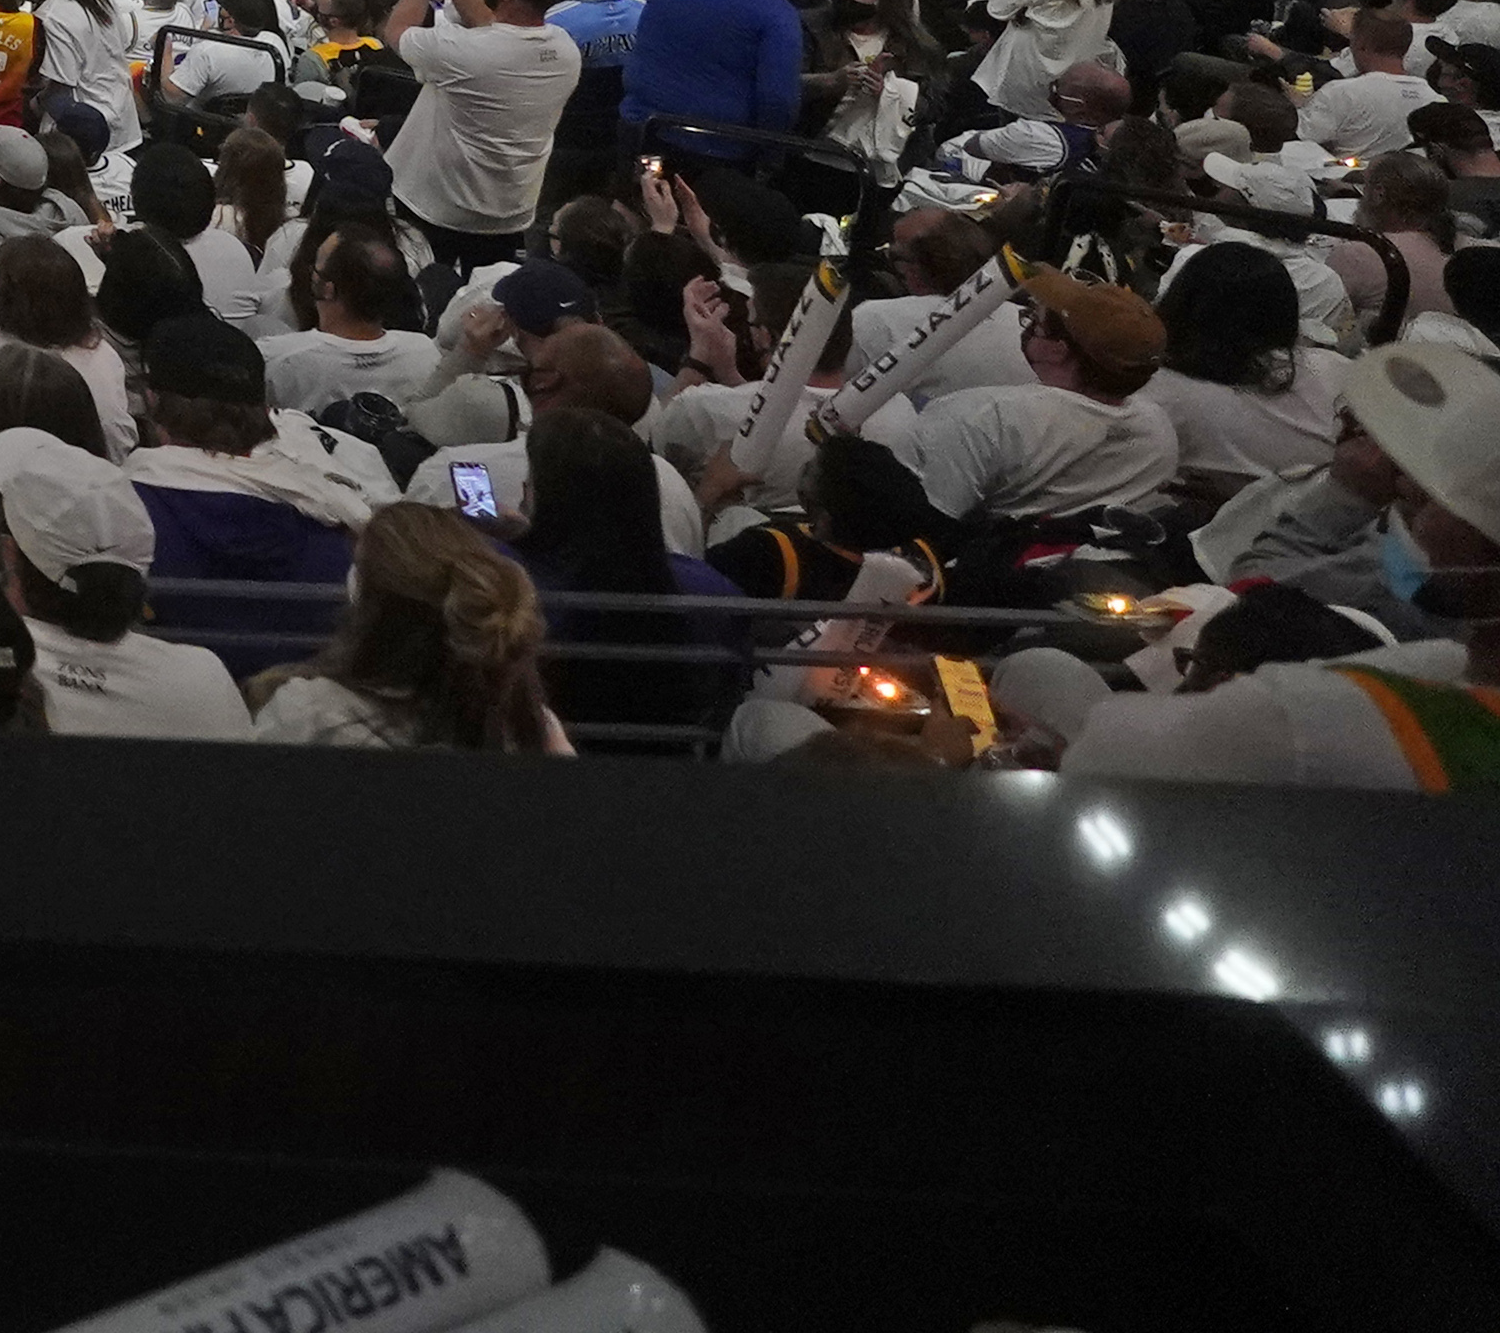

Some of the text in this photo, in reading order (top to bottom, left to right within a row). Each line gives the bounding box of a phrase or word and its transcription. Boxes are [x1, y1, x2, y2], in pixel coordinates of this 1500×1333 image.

[738, 295, 814, 438] JAZZ GO
[853, 259, 999, 394] JAZZ GO
[251, 1222, 473, 1333] AMERICA
